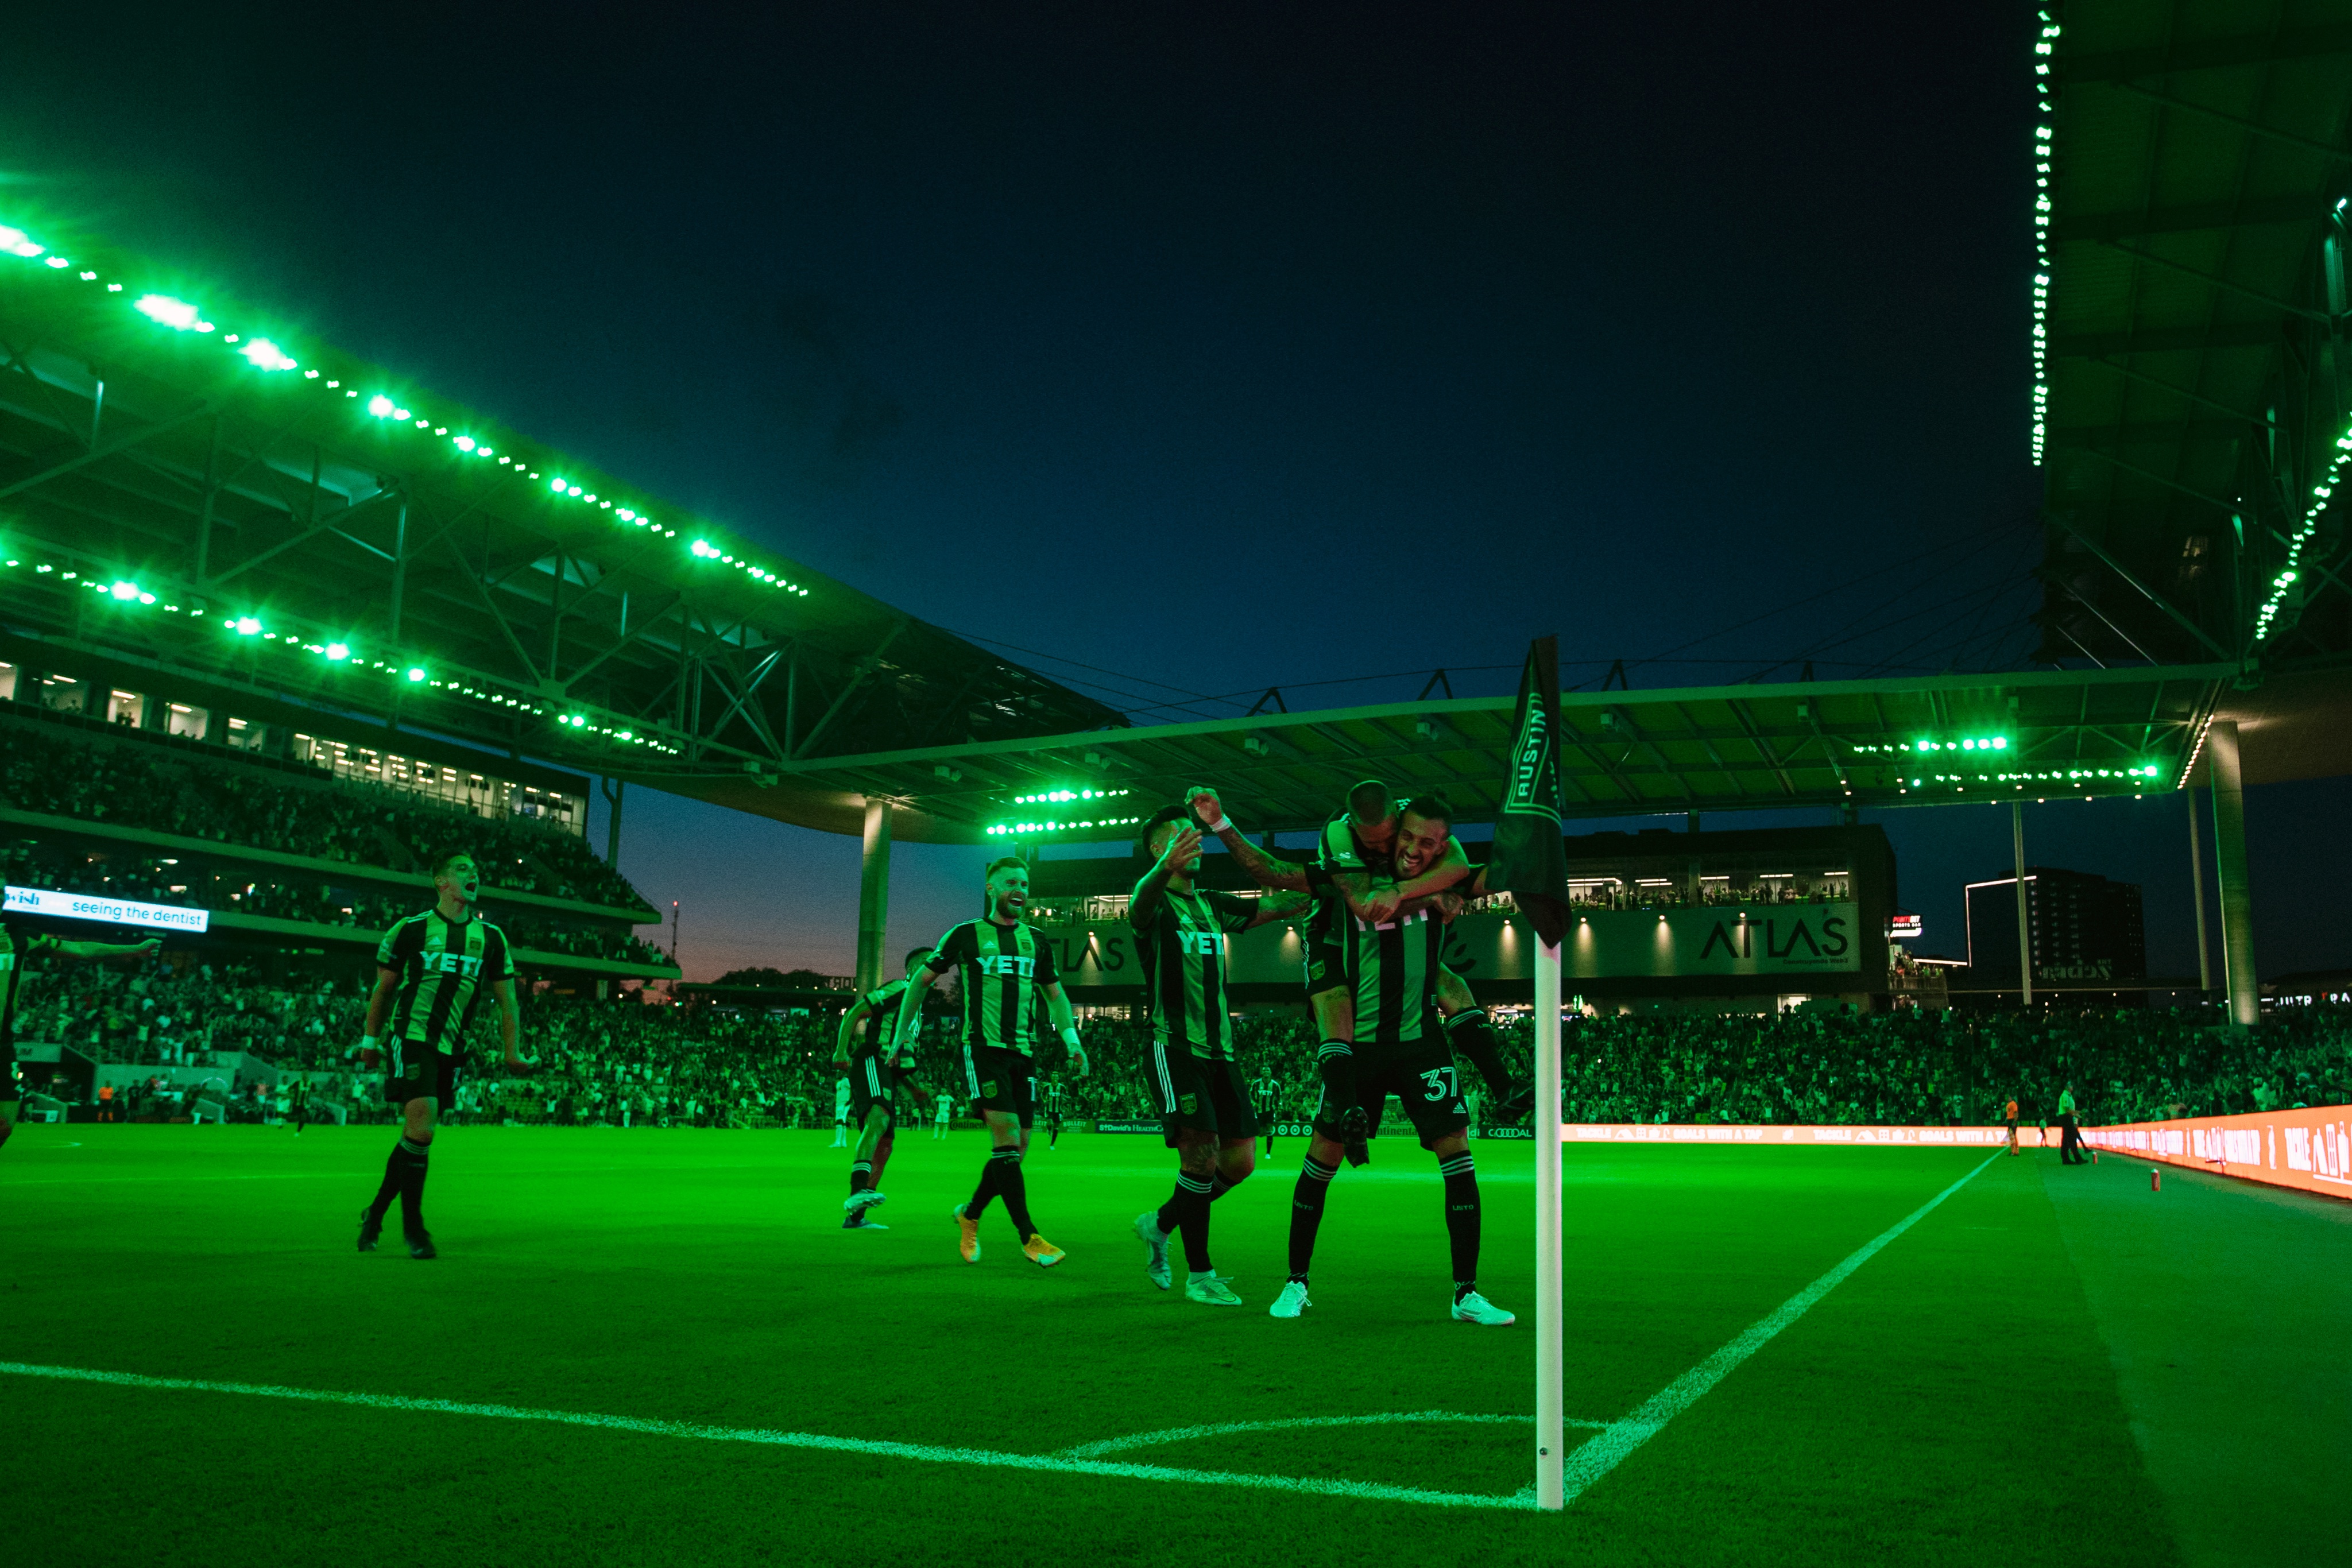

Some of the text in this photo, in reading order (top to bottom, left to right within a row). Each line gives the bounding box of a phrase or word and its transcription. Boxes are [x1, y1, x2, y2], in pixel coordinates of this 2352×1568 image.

[1518, 710, 1546, 797] AUSTIN
[72, 901, 202, 925] seeing the dentist
[1700, 917, 1848, 959] ATLAS
[419, 950, 483, 977] YETI
[1048, 938, 1124, 973] LAS
[1419, 1066, 1457, 1101] 37
[1576, 1127, 1763, 1140] TACKLE GOALS WITH A TAP
[1813, 1129, 1852, 1141] TACKLE
[1918, 1130, 1954, 1142] GOALS
[1955, 1130, 1984, 1142] WITH
[1985, 1130, 1994, 1142] A
